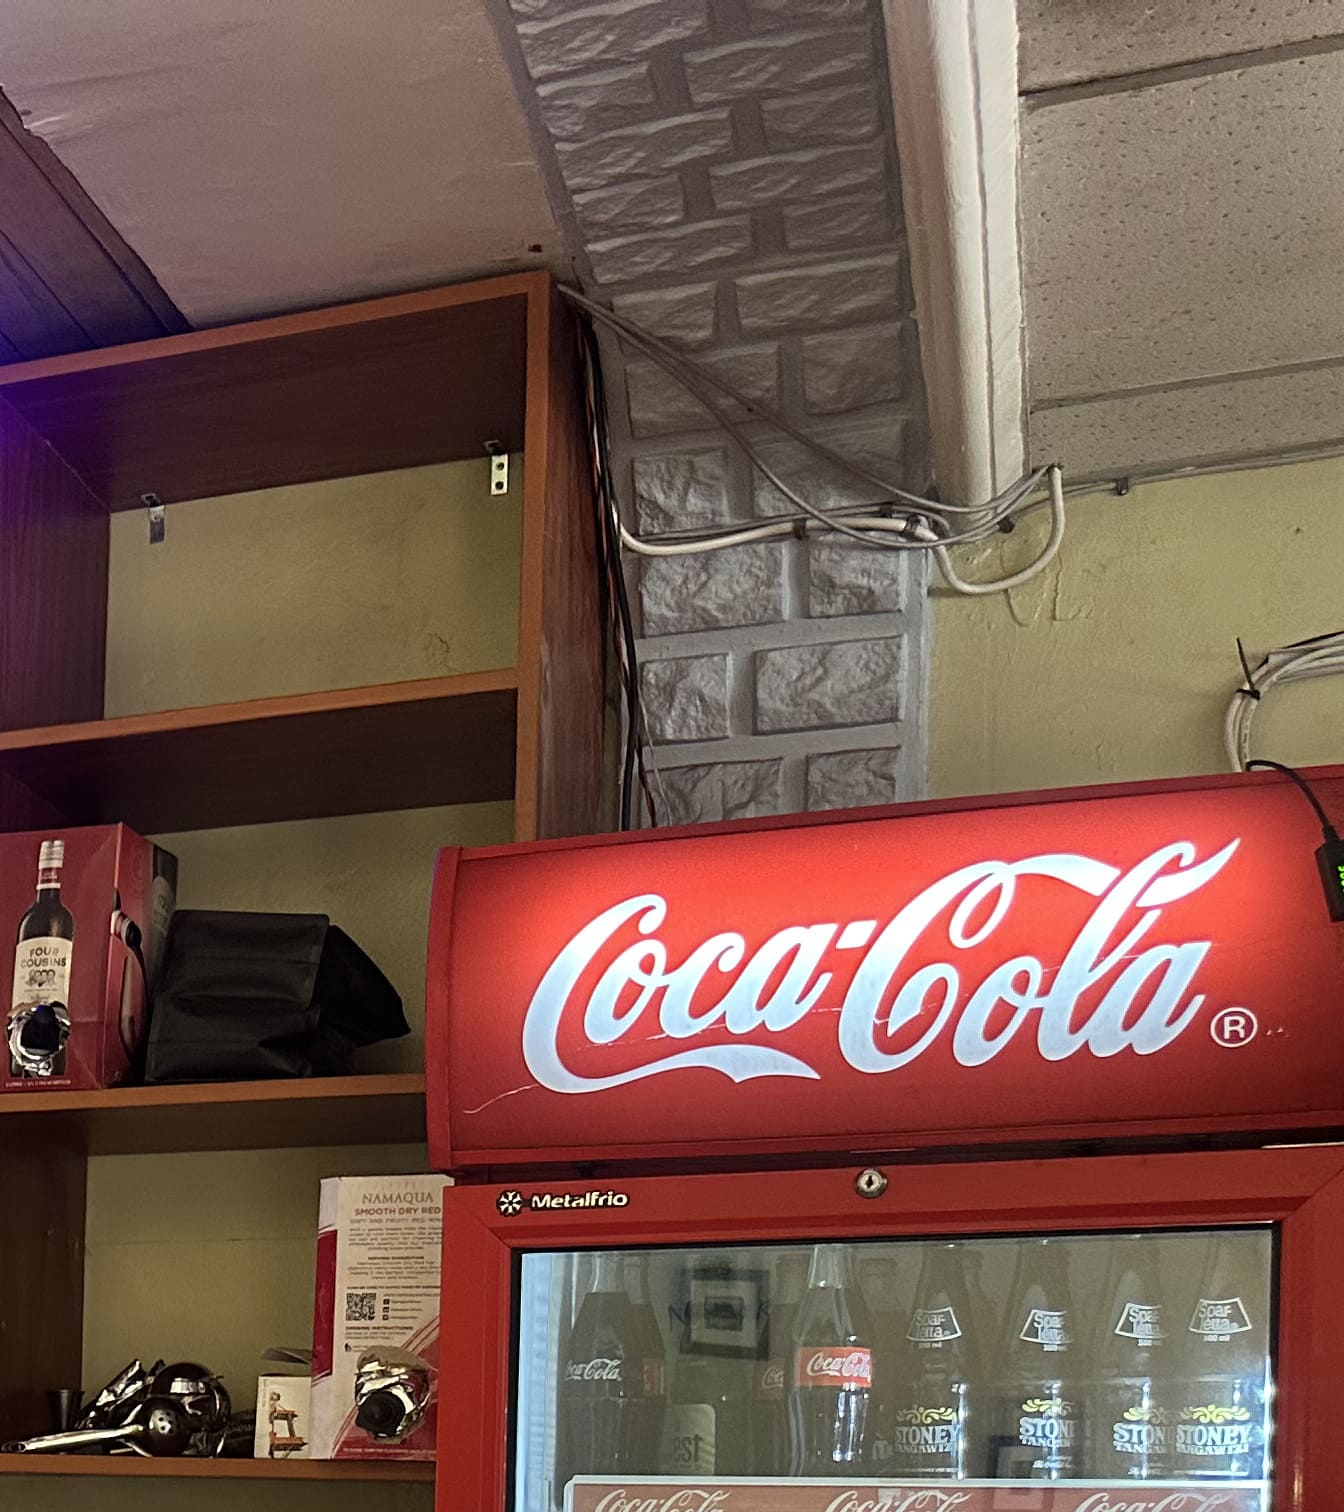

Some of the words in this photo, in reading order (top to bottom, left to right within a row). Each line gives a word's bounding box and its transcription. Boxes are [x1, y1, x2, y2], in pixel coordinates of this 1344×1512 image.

[29, 947, 60, 957] FOUR
[20, 957, 67, 968] COUSINS
[521, 836, 1242, 1094] Coca-Cola
[362, 1191, 434, 1205] NAMAQUA
[531, 1189, 630, 1210] Metalfrio
[354, 1207, 396, 1216] SMOOTH
[398, 1206, 419, 1216] DRY
[421, 1206, 442, 1215] RED
[1176, 1424, 1251, 1446] STONEY
